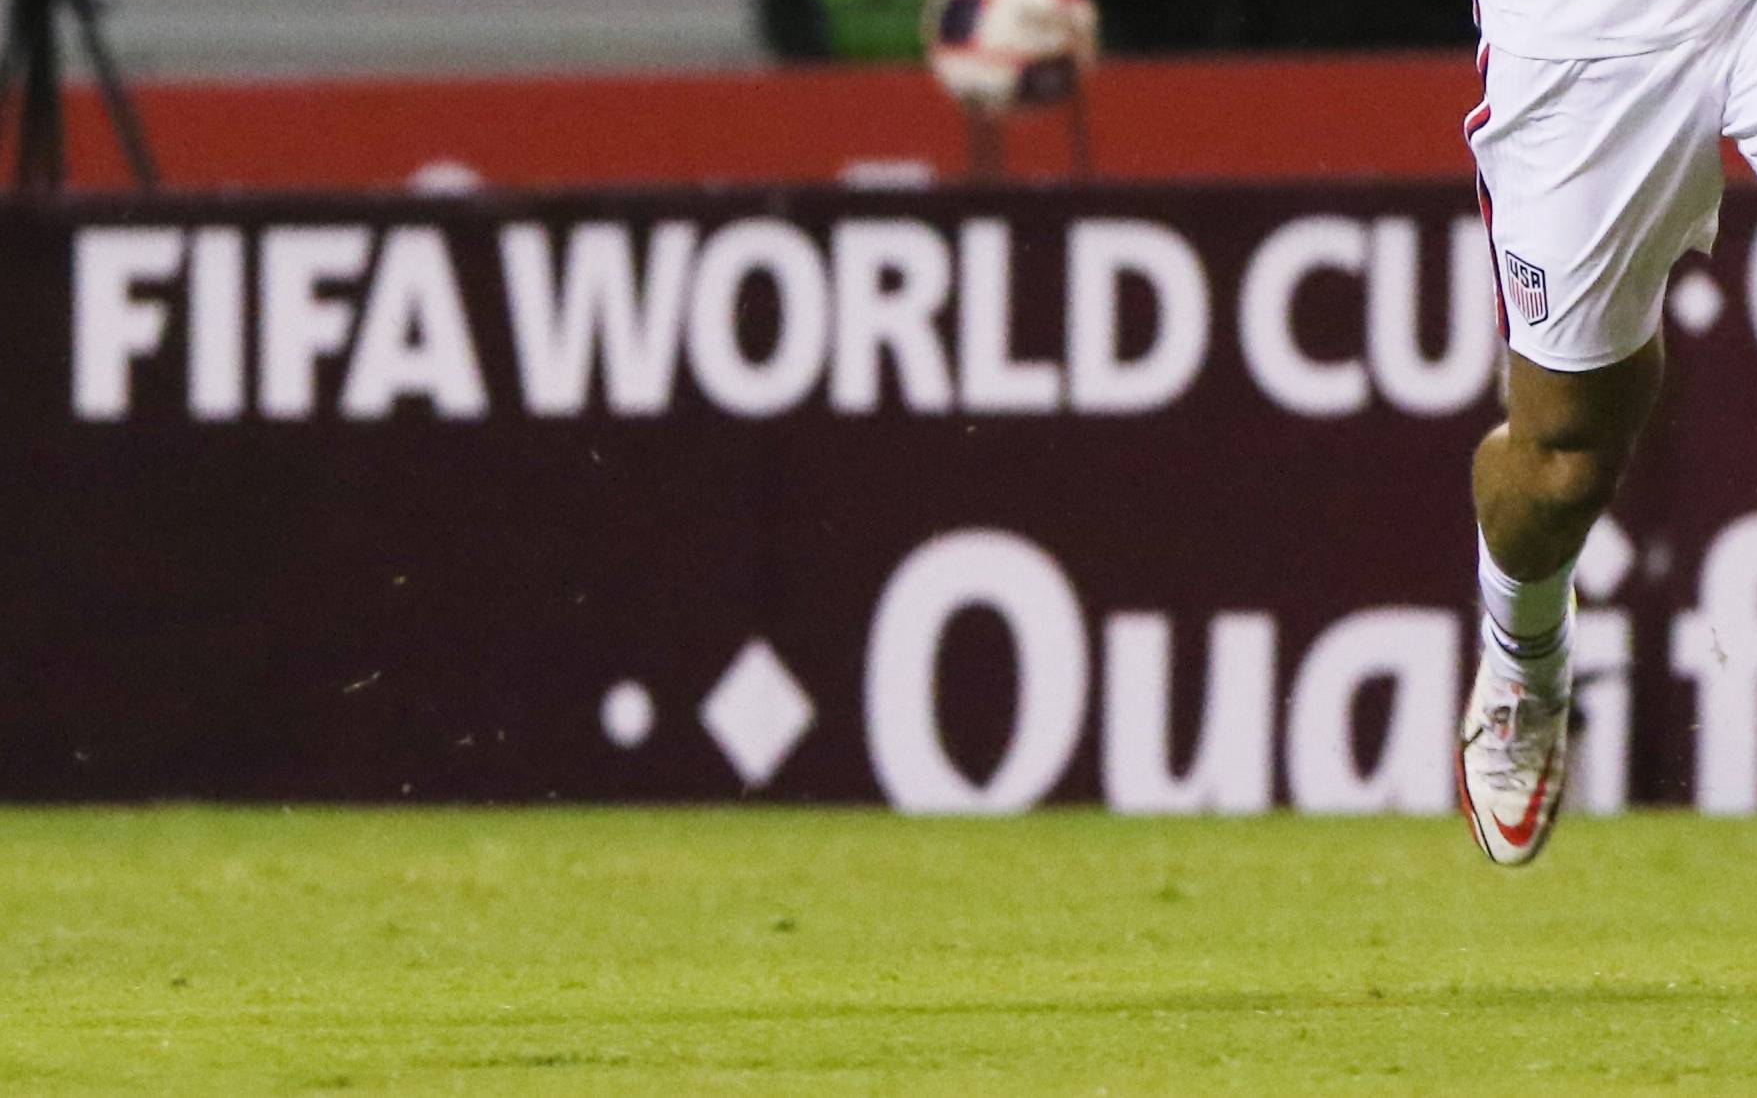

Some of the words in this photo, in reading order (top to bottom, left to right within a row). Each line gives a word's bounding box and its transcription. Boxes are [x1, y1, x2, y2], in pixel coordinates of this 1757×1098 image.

[71, 223, 489, 422] FIFA
[500, 215, 1213, 418] WORLD
[1238, 215, 1508, 418] CU
[1509, 258, 1541, 290] USA
